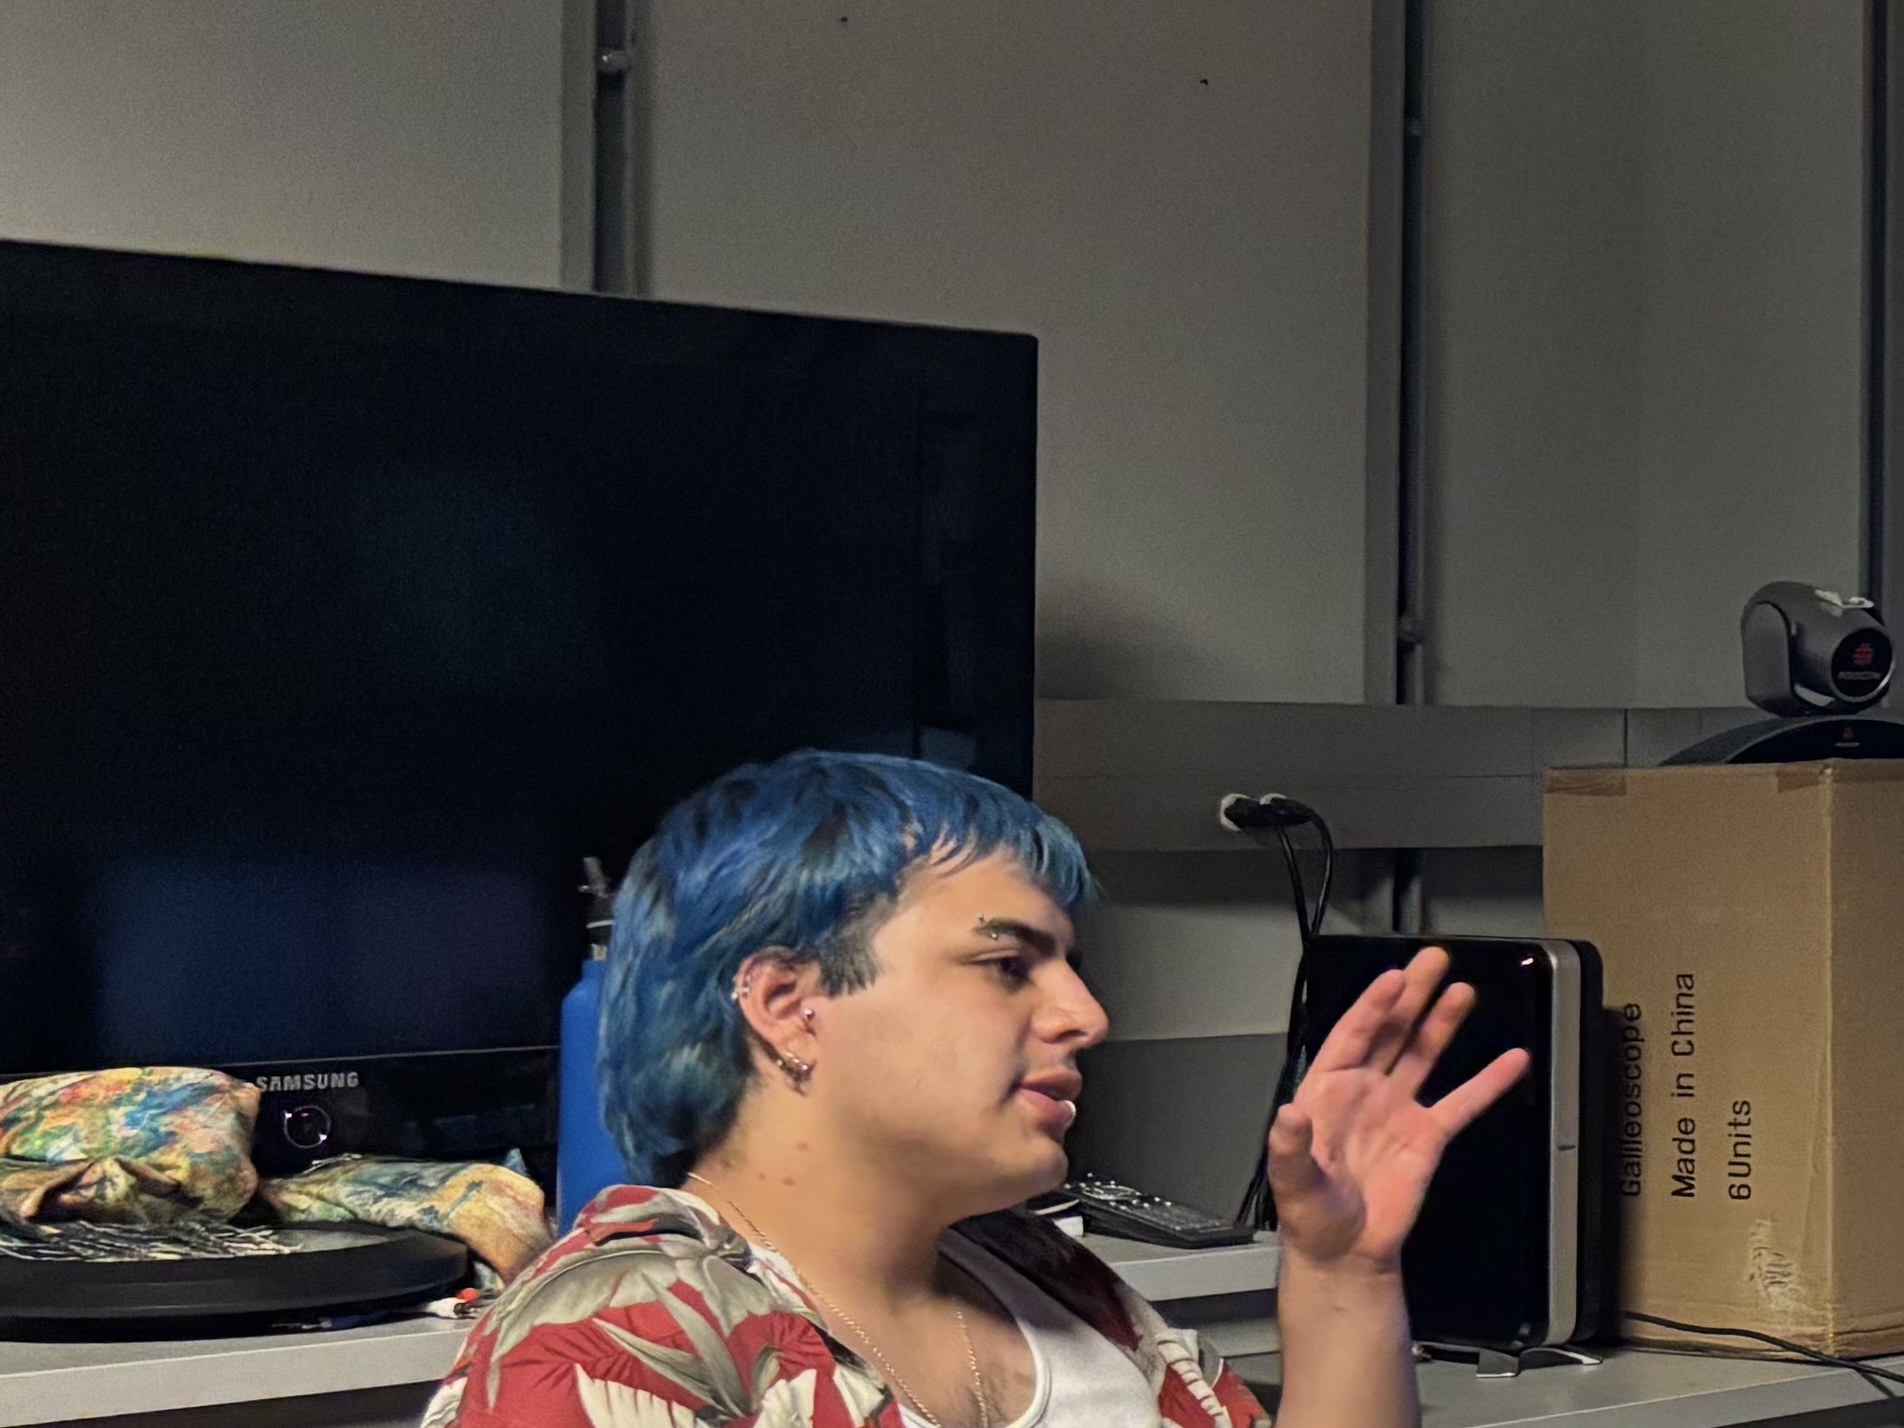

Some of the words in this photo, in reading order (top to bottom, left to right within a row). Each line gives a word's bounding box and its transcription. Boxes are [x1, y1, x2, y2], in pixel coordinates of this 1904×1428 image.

[1671, 973, 1695, 1056] China
[256, 1072, 359, 1092] SAMSUNG
[1619, 1002, 1645, 1197] Galileoscope
[1670, 1073, 1695, 1097] in
[1671, 1117, 1696, 1198] Made
